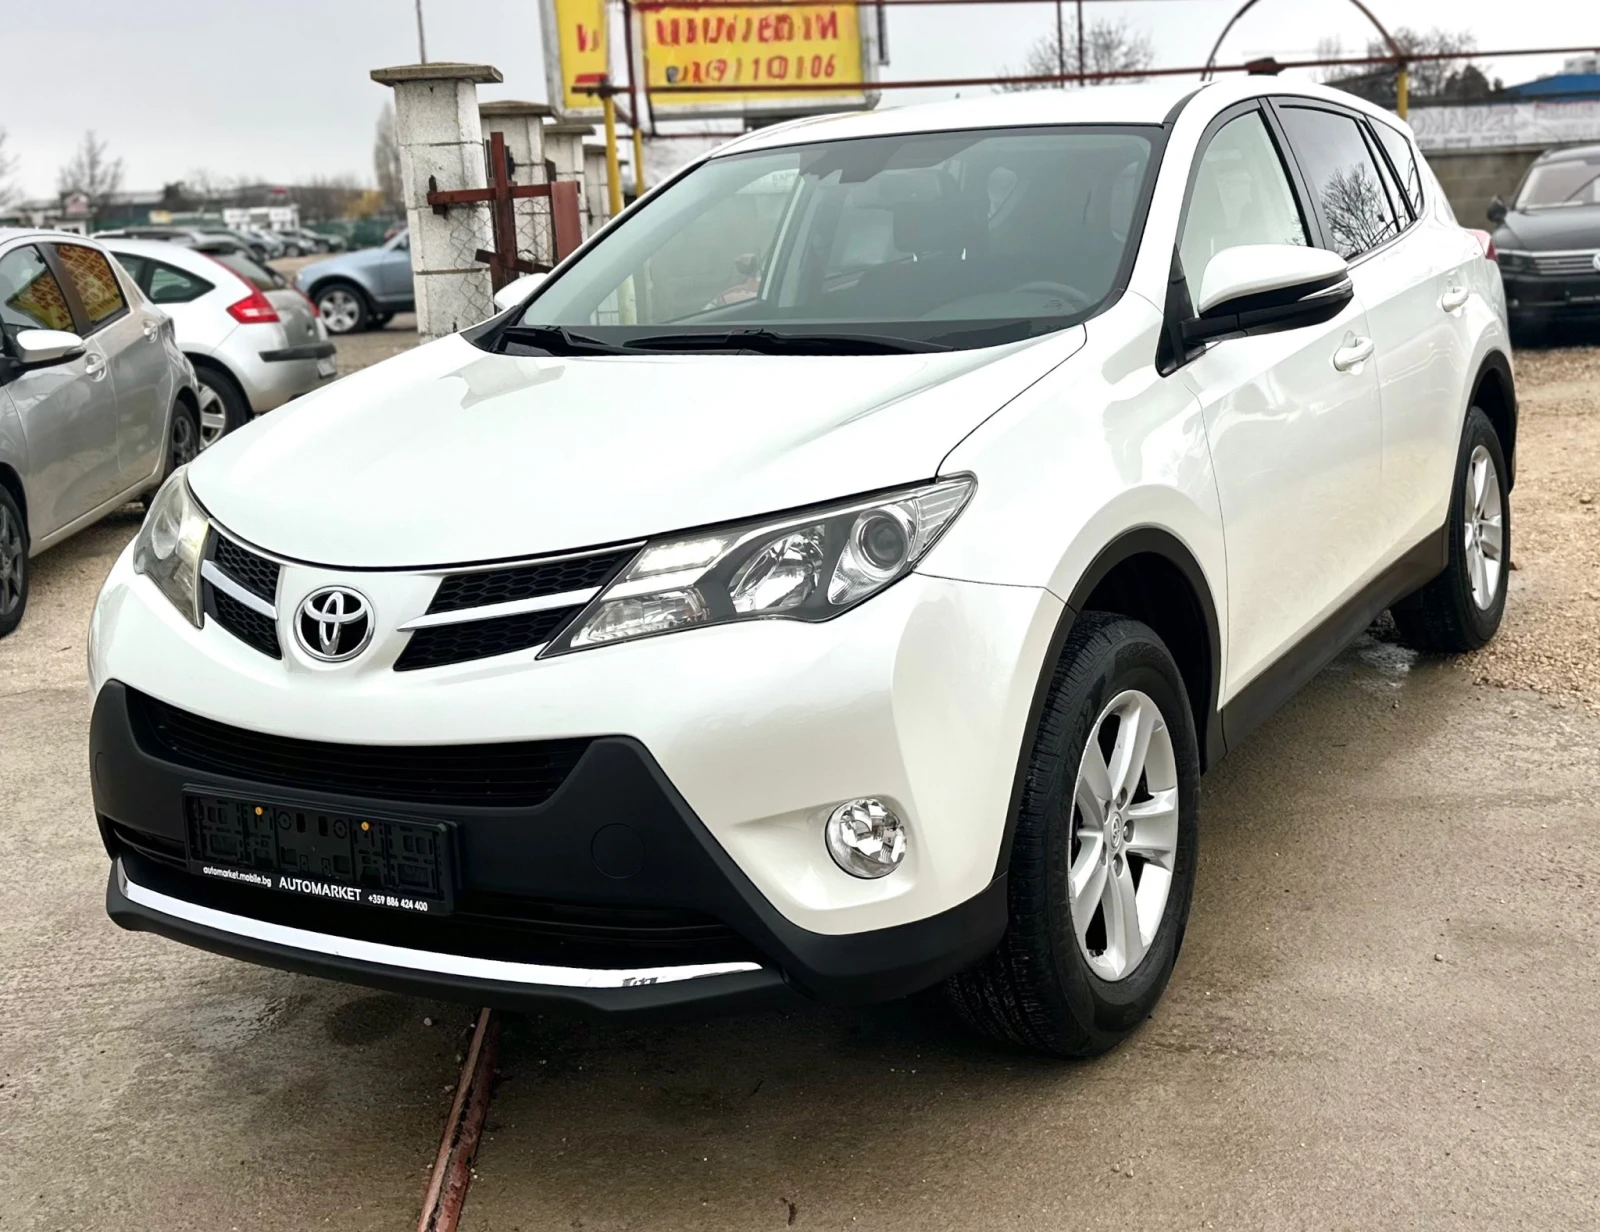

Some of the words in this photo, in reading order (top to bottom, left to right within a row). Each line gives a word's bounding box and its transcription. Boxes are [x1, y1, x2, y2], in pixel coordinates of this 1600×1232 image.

[203, 866, 271, 888] automarket.mobile.bg
[279, 876, 361, 901] AUTOMARKET
[368, 894, 385, 905] +359
[386, 896, 399, 907] 886
[400, 898, 413, 909] 424
[414, 900, 428, 911] 400
